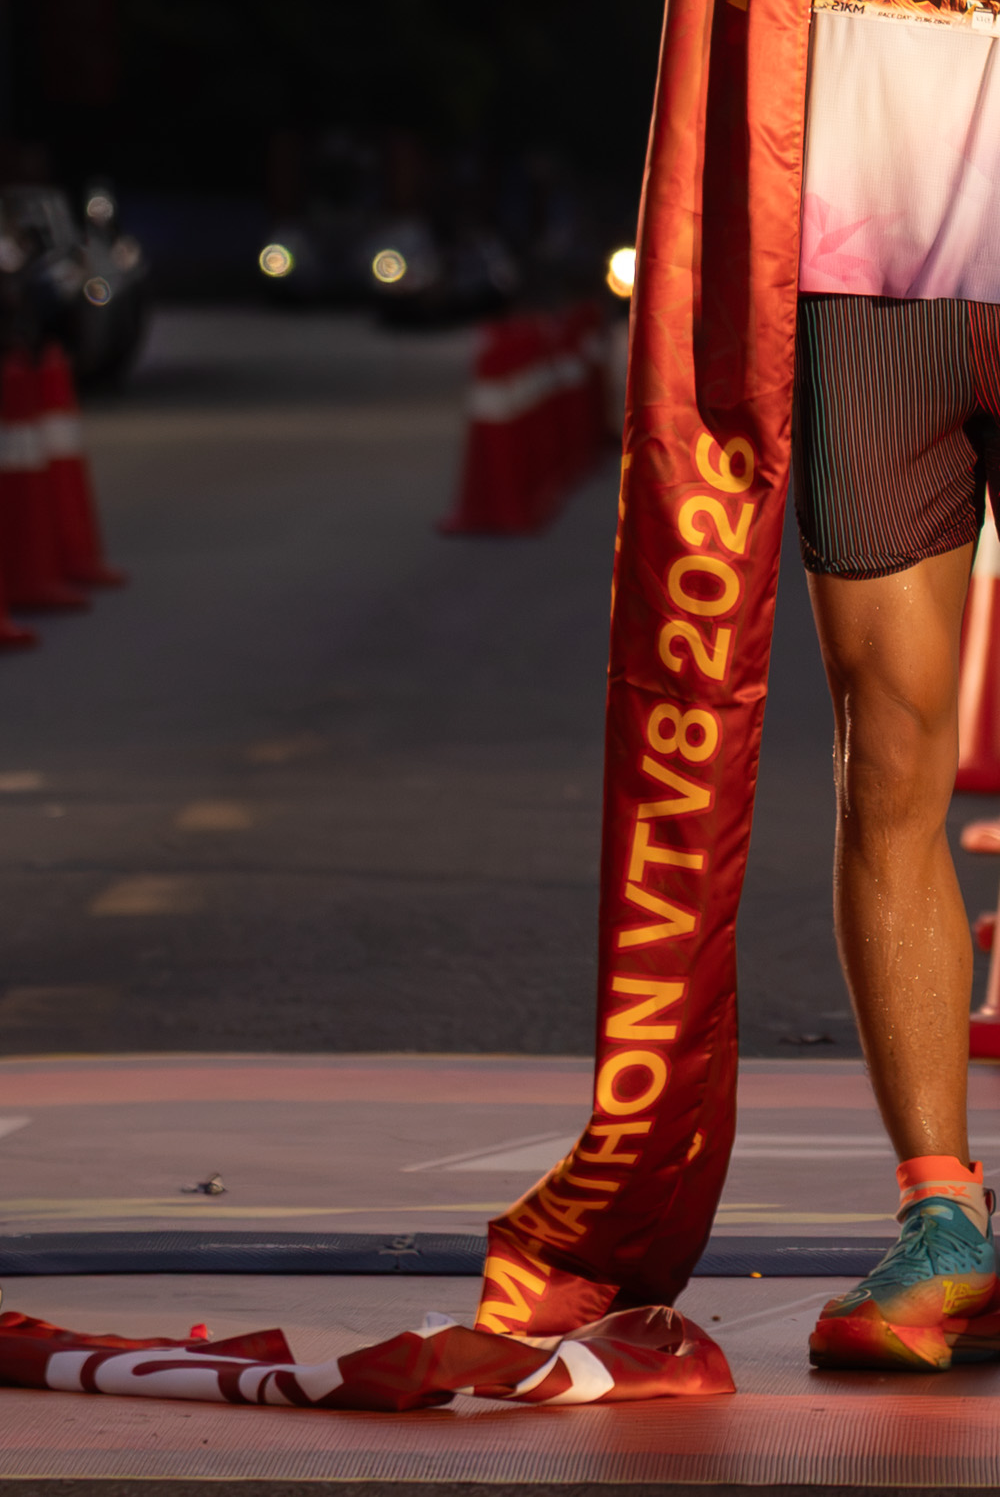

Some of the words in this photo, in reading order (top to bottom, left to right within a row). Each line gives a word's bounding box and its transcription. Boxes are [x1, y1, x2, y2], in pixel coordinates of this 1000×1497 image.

[831, 1, 865, 15] 21KM
[658, 432, 755, 682] 2026
[617, 703, 719, 949] VTV8
